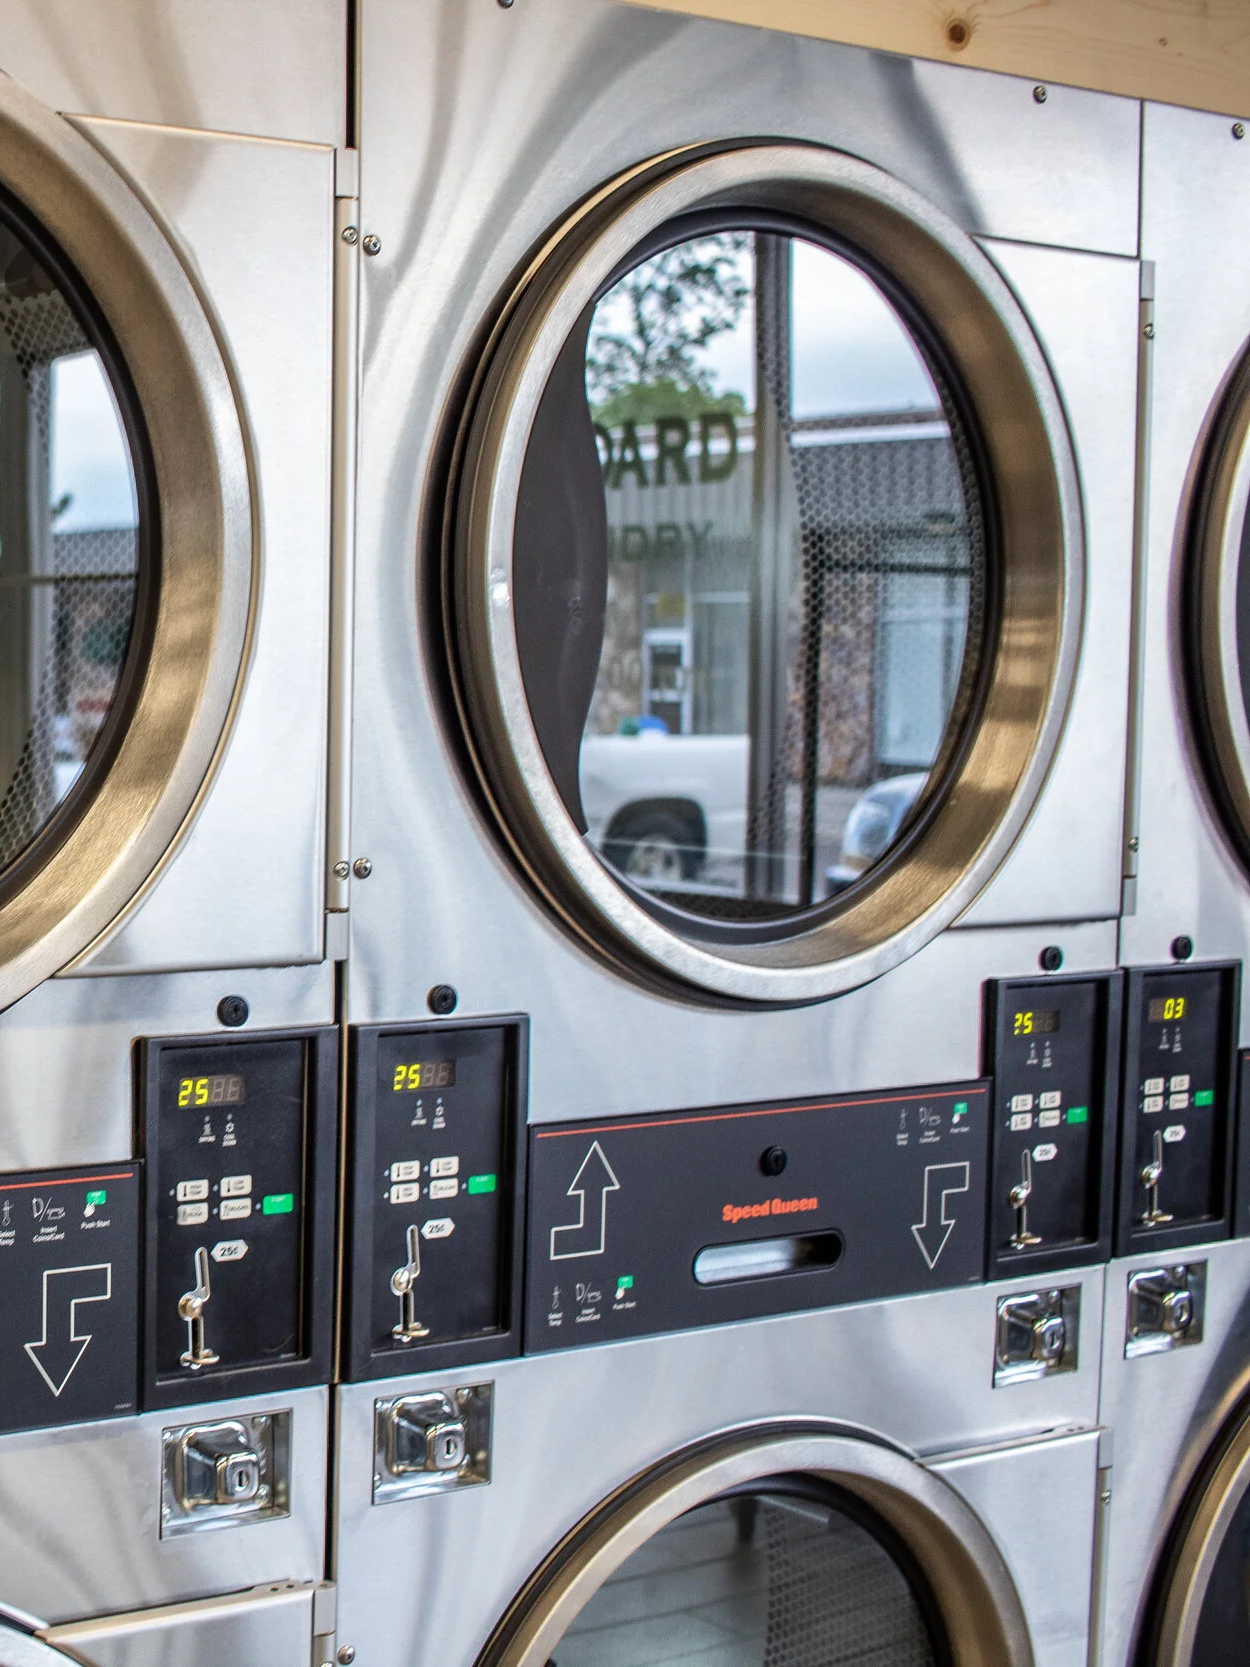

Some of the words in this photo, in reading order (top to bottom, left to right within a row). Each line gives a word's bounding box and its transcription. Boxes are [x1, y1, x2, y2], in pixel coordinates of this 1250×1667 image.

[607, 520, 713, 562] DRY
[1163, 997, 1185, 1020] 03
[393, 1063, 420, 1091] 25
[178, 1078, 209, 1107] 25
[722, 1199, 770, 1224] Speed
[771, 1197, 818, 1215] Queen
